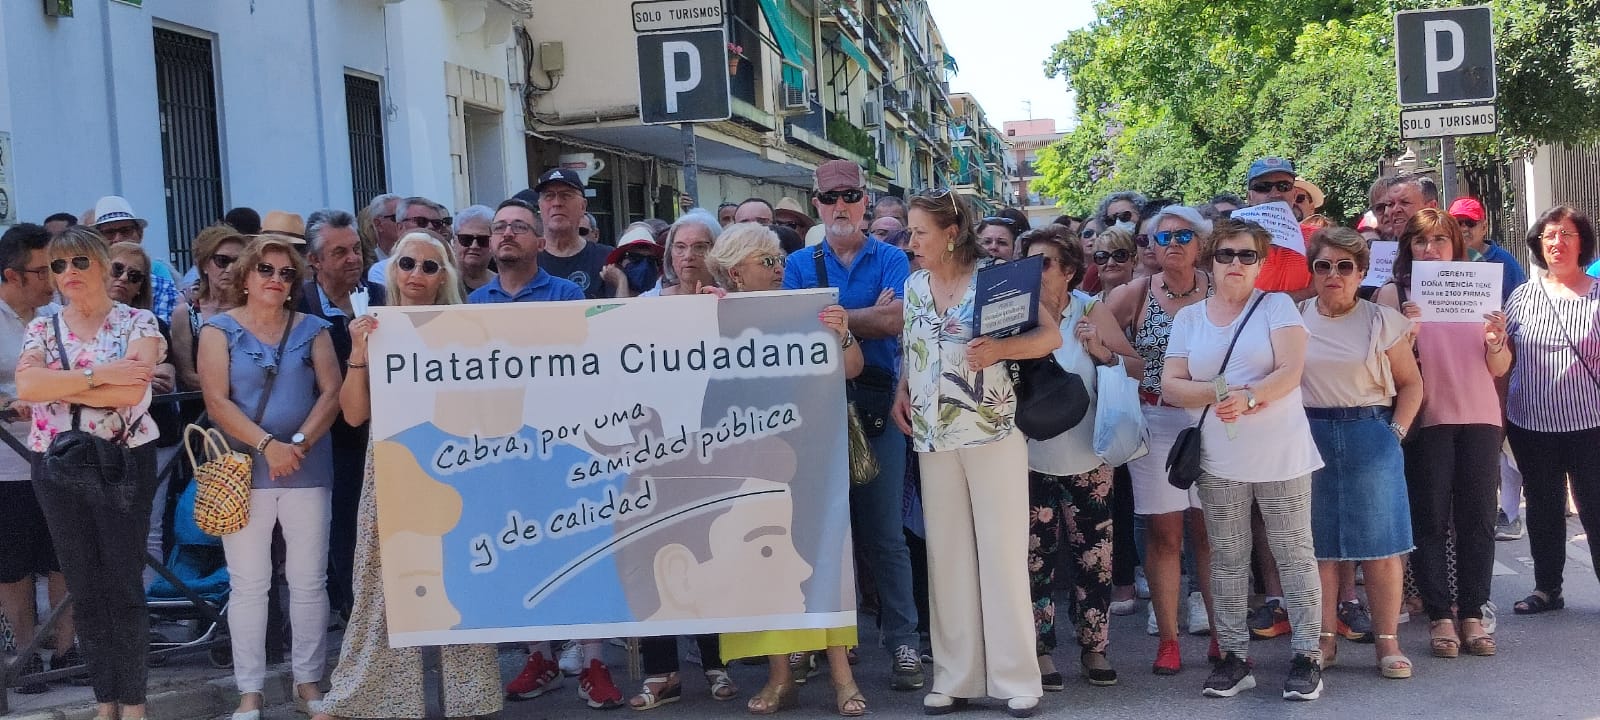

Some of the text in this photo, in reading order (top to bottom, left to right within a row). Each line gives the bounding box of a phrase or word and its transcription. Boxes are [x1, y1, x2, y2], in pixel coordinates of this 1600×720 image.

[635, 6, 720, 23] SOLO TURISMOS
[1423, 19, 1465, 94] P
[662, 41, 702, 114] P
[1403, 113, 1494, 130] SOLO TURISMOS
[1421, 280, 1443, 288] DOÑA
[1462, 290, 1491, 298] FIRMAS
[386, 338, 829, 384] Plataforma Ciudadana
[541, 423, 581, 454] por
[701, 408, 797, 457] pública
[474, 480, 652, 568] y de calidad
